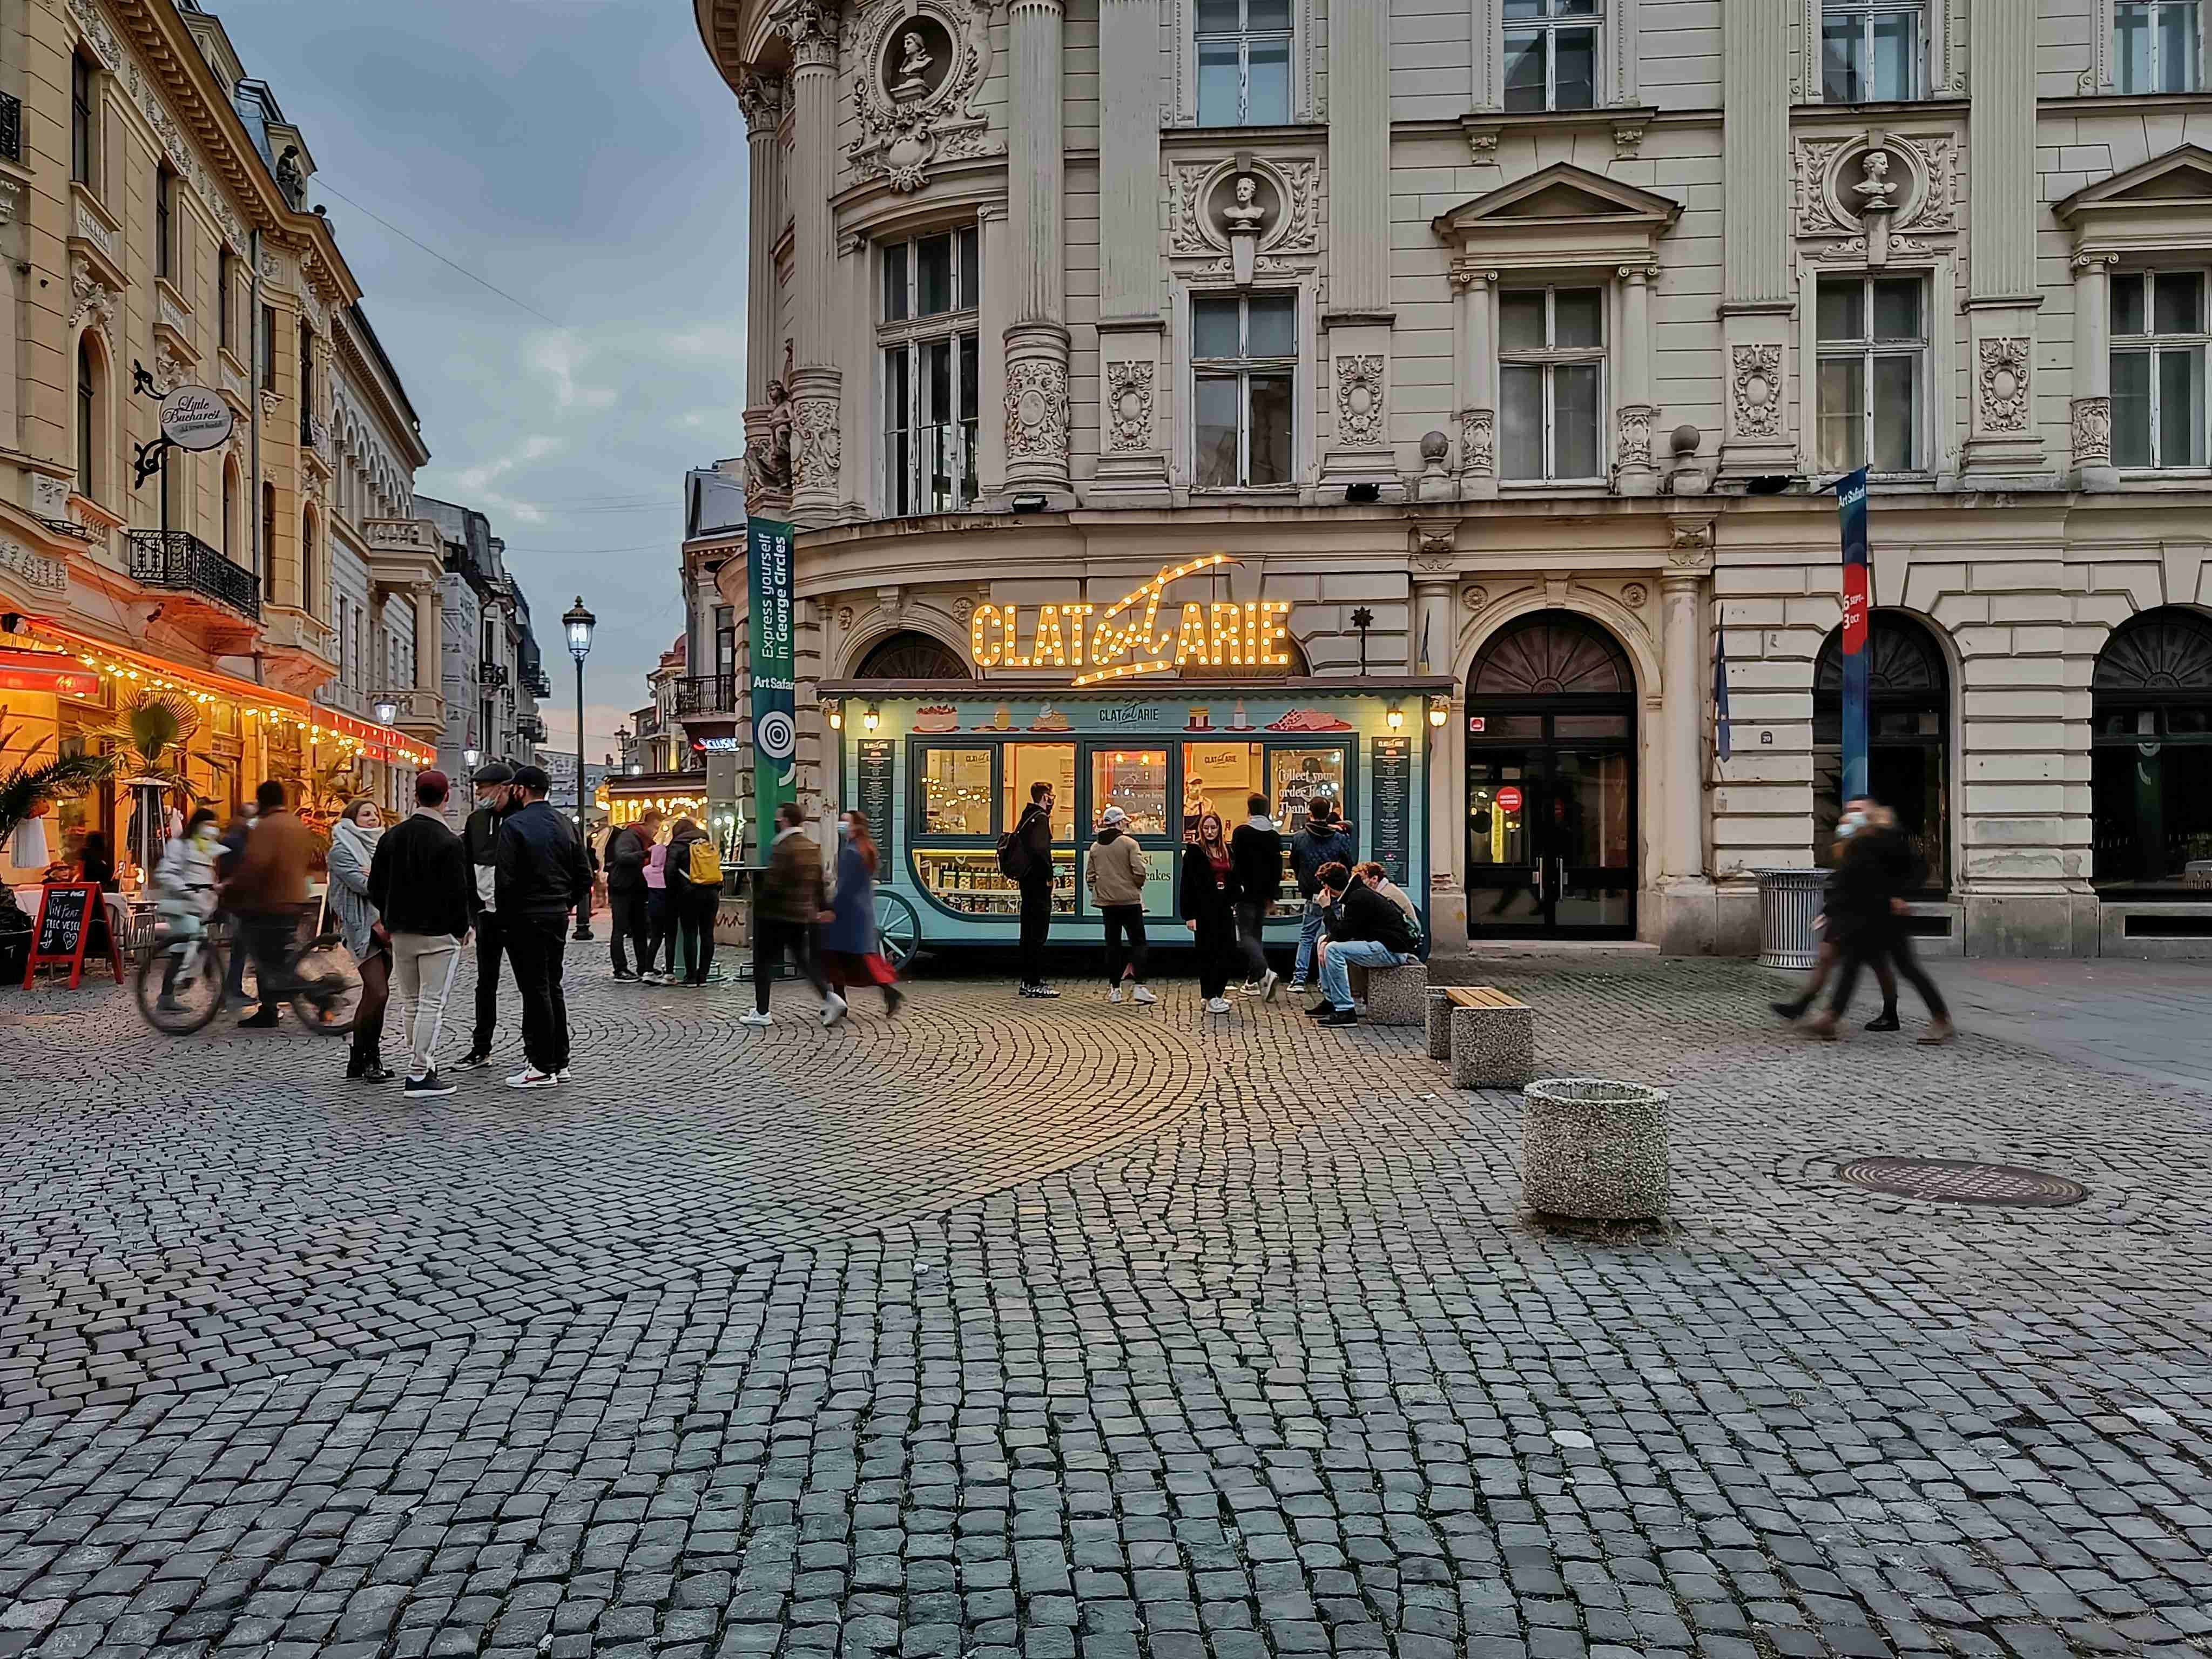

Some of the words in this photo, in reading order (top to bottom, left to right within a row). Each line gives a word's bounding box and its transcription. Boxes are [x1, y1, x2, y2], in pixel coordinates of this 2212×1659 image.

[161, 408, 220, 424] Bucharest
[759, 532, 774, 595] yourself
[774, 536, 786, 585] Circles
[1842, 595, 1850, 611] 6
[776, 589, 790, 642] George
[1843, 613, 1850, 630] 3
[762, 599, 775, 658] Express
[776, 646, 789, 659] in
[753, 676, 770, 688] Art
[1278, 768, 1310, 783] Collect
[1312, 772, 1335, 784] your
[1278, 801, 1311, 814] Thank
